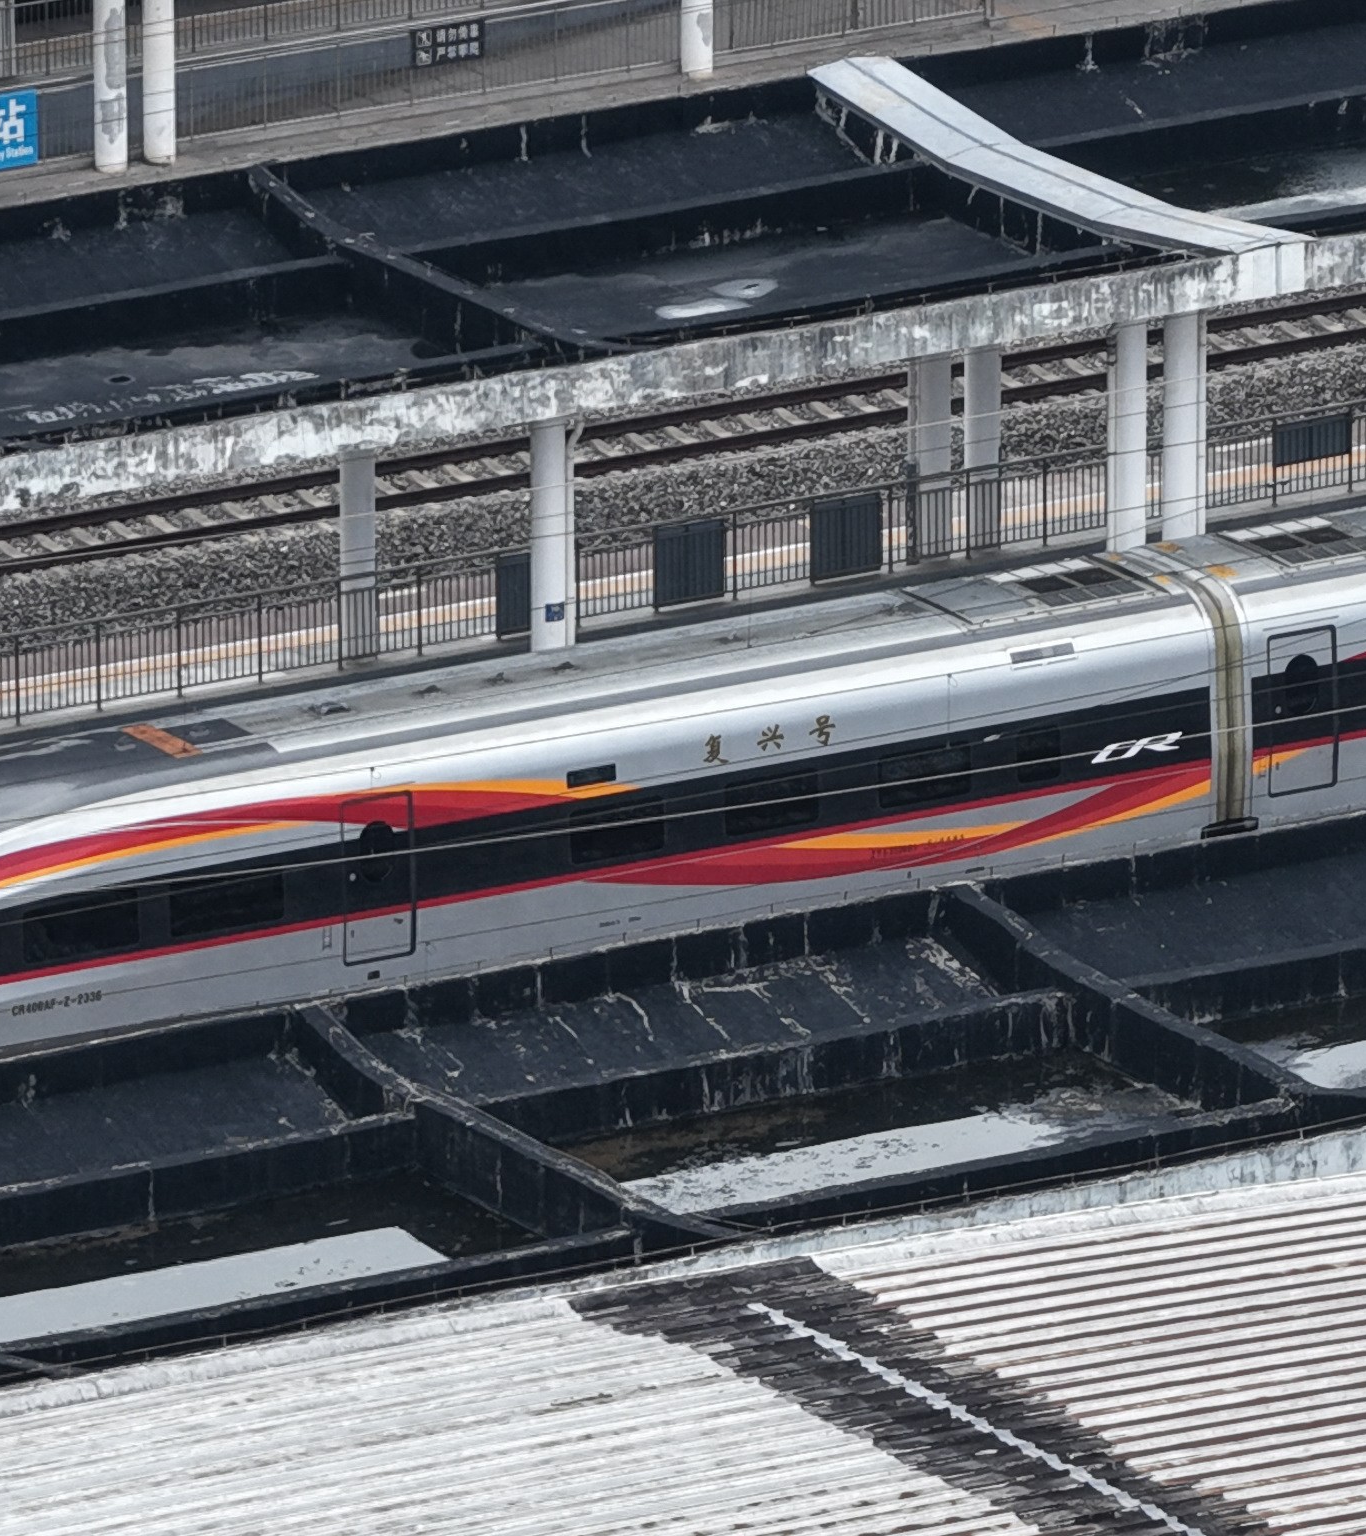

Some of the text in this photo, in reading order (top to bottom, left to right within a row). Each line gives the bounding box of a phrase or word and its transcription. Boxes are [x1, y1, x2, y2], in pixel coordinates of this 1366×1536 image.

[6, 145, 33, 158] Station
[703, 714, 836, 764] 复兴号
